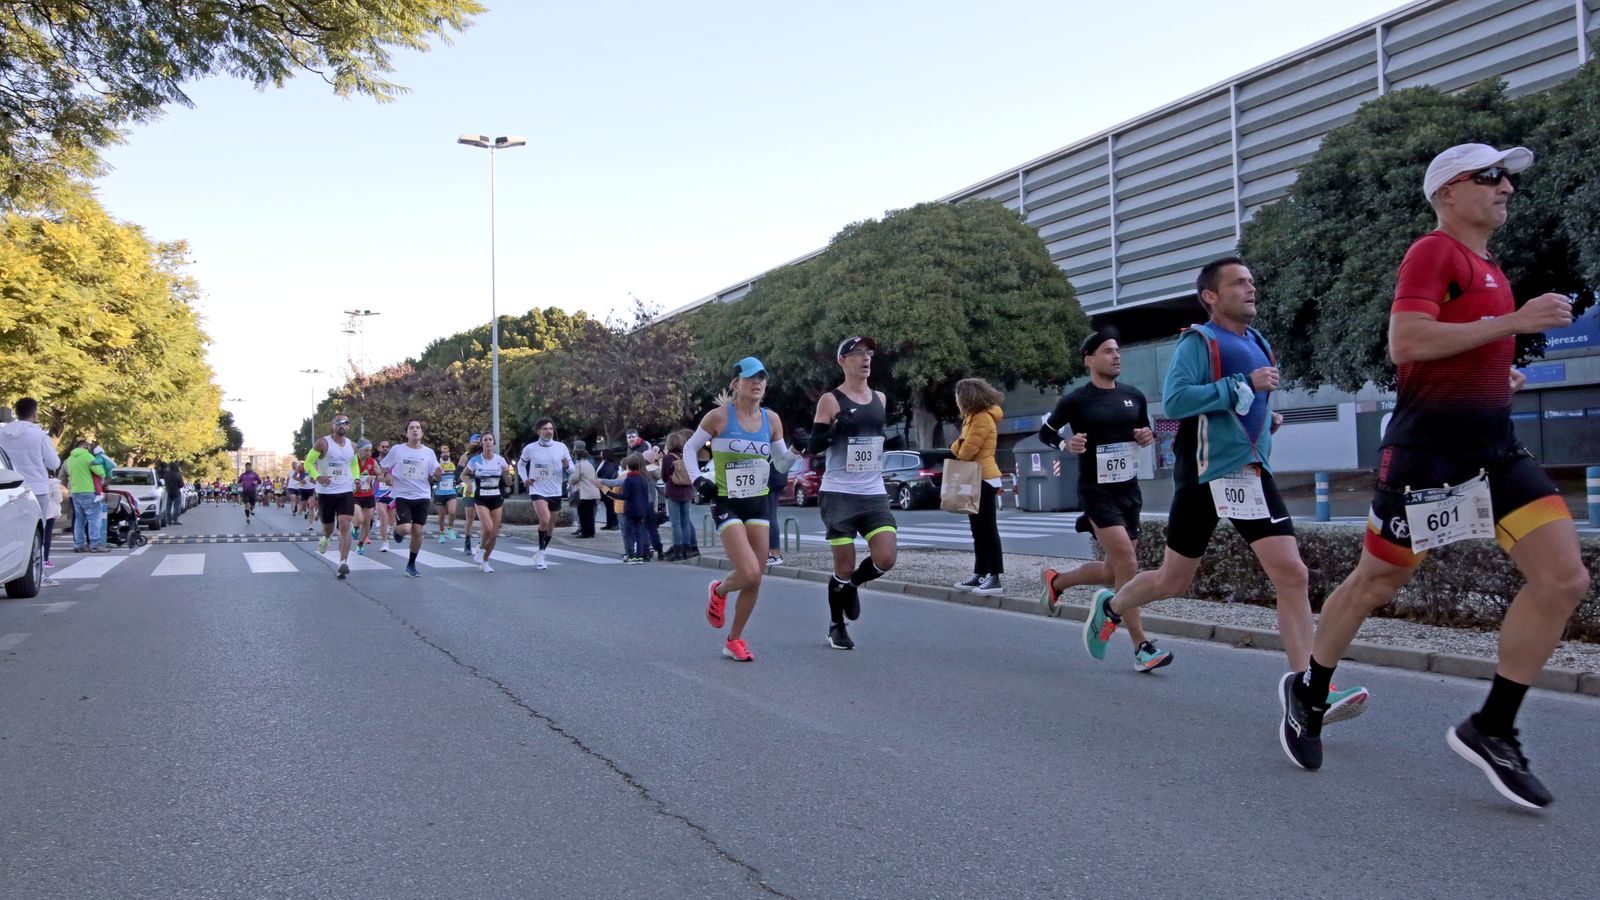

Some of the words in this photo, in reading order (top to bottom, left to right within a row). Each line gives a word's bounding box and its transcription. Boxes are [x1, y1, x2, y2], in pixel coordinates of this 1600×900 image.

[855, 450, 872, 462] 303
[1106, 458, 1126, 471] 676
[736, 474, 755, 487] 578
[1225, 487, 1245, 504] 600
[1427, 505, 1459, 531] 601
